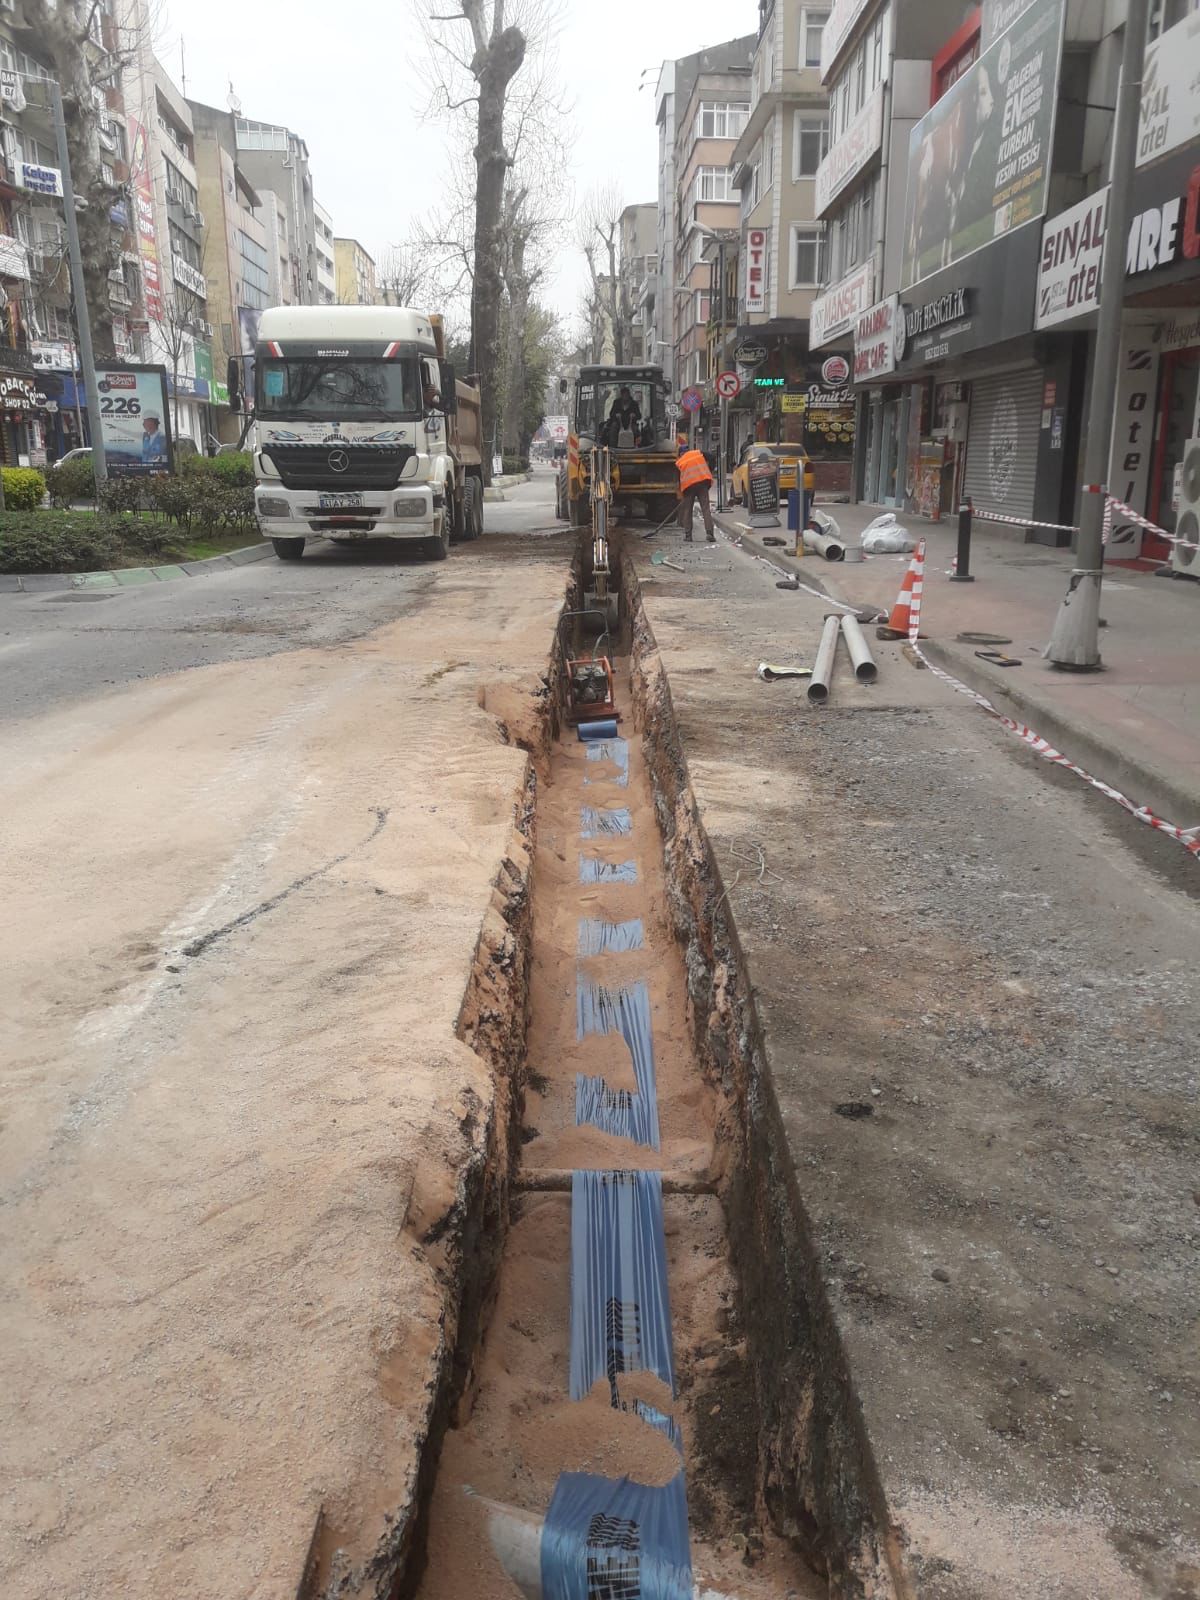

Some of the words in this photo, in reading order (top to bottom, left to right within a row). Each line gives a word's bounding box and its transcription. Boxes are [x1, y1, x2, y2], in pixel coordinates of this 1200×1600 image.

[1003, 88, 1023, 137] EN
[998, 119, 1035, 164] KURBAN
[1140, 117, 1169, 157] otel
[1042, 205, 1104, 273] SINAL
[750, 231, 764, 299] OTEL
[0, 377, 36, 405] OBACCO
[5, 398, 21, 408] SHOP
[22, 400, 30, 409] 02
[100, 397, 141, 414] 226
[808, 385, 840, 402] Simit
[1123, 392, 1147, 504] otel
